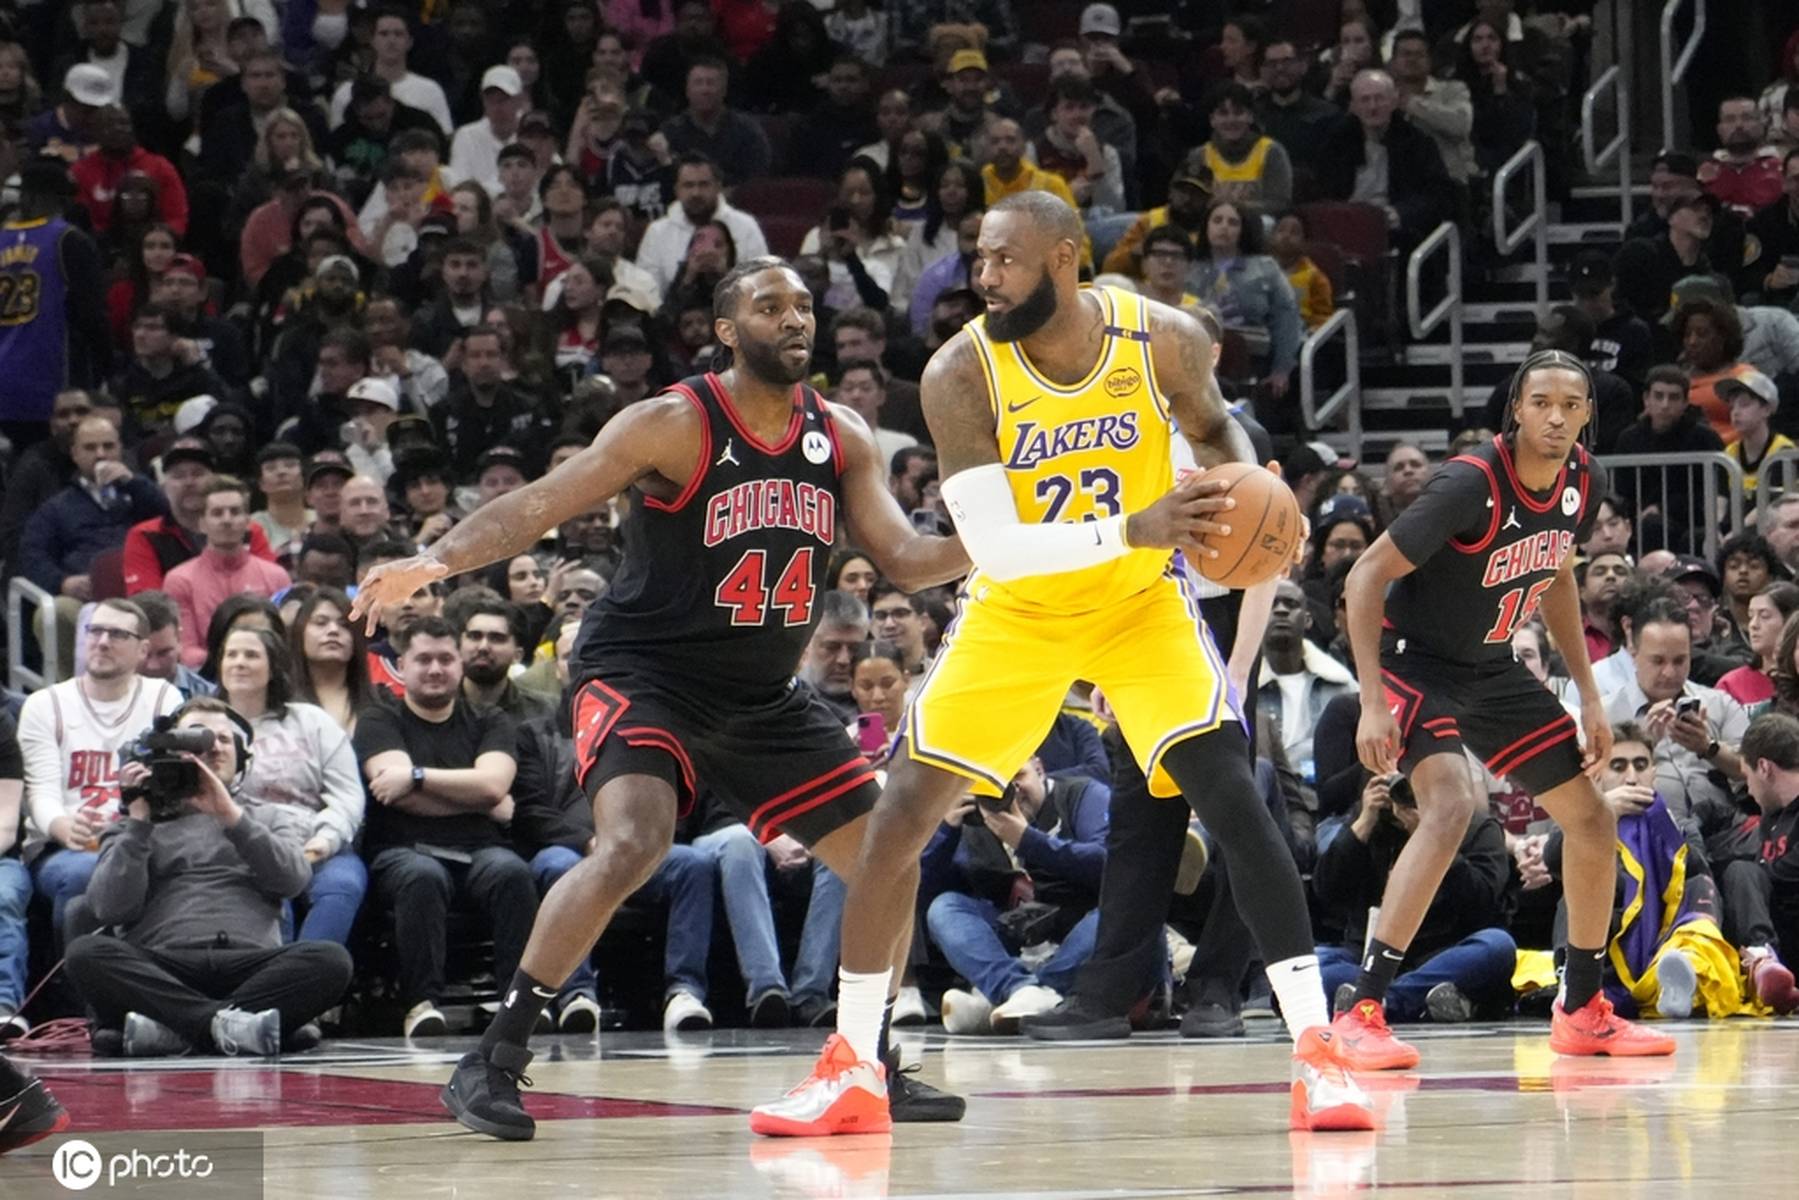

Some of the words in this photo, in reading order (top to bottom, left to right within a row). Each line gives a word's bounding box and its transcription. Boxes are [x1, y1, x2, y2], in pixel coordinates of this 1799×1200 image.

[1003, 411, 1140, 471] LAKERS
[704, 478, 835, 547] CHICAGO
[1035, 467, 1121, 524] 23
[714, 547, 816, 627] 44
